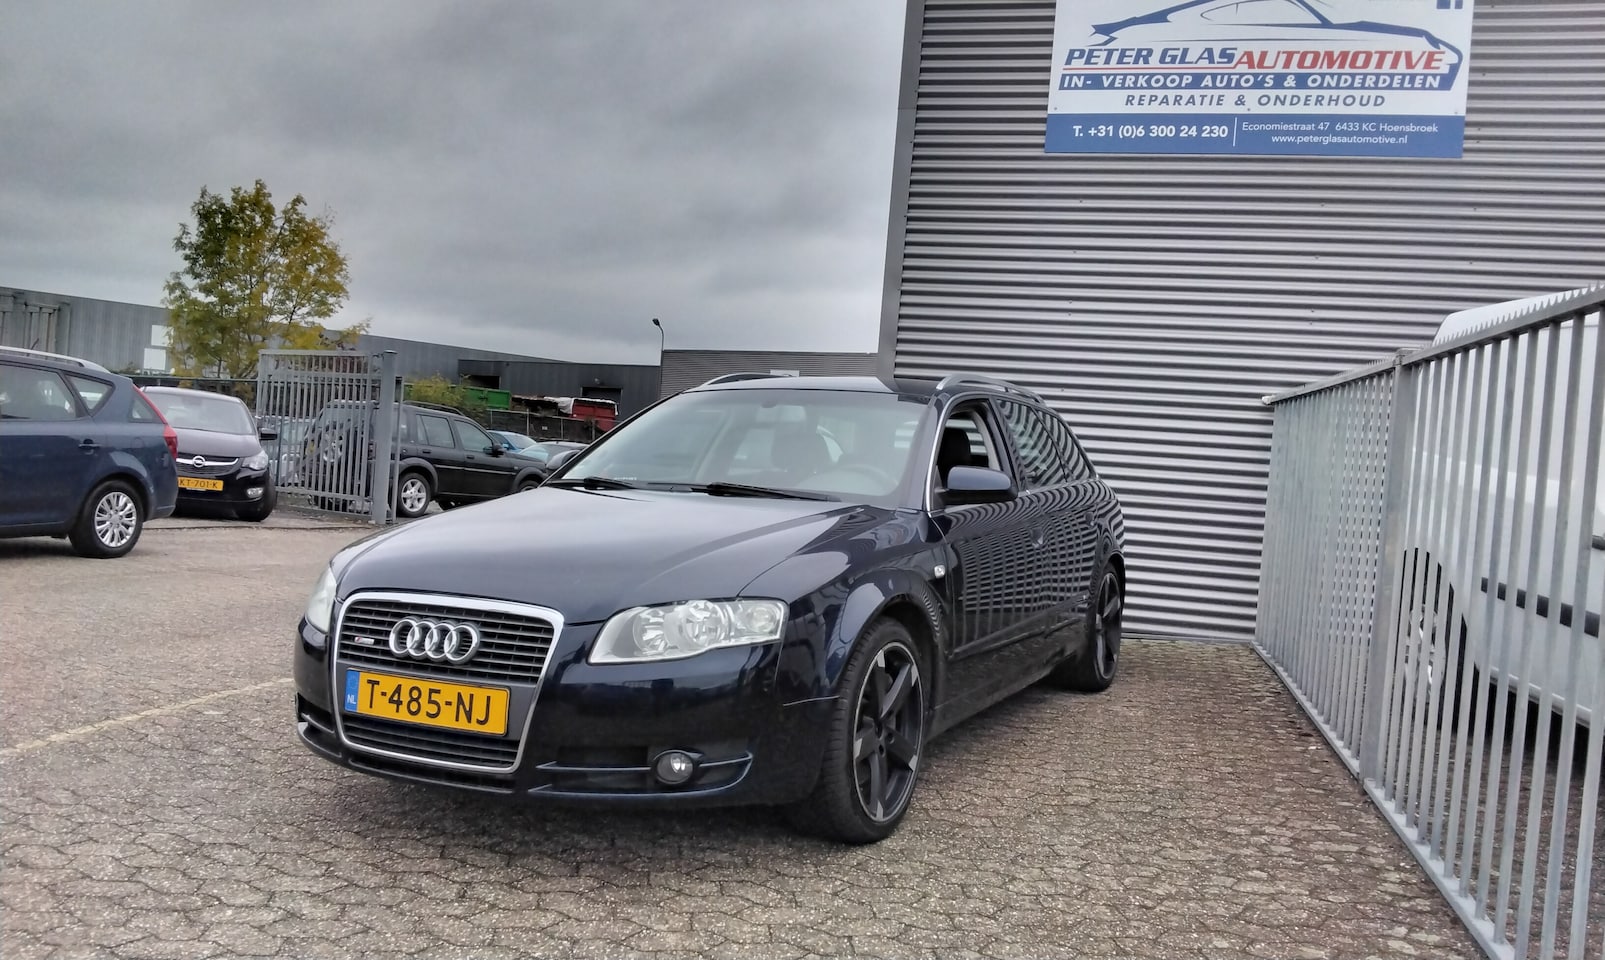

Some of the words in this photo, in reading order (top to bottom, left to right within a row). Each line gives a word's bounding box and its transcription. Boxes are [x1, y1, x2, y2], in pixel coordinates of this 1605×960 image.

[1064, 47, 1154, 66] PETER
[1063, 75, 1092, 88] IN-
[1101, 74, 1193, 88] VERKOOP
[1200, 74, 1275, 88] AUTO'S
[1283, 75, 1297, 87] &
[1306, 74, 1441, 88] ONDERDELEN
[1125, 94, 1226, 107] REPARATIE
[1234, 95, 1247, 106] &
[1257, 94, 1386, 107] ONDERHOUD
[1072, 125, 1084, 137] T.
[1088, 125, 1114, 137] +31
[1118, 125, 1146, 139] (0)6
[1149, 125, 1176, 138] 300
[1179, 125, 1198, 138] 24
[1201, 125, 1229, 138] 230
[1242, 122, 1316, 132] Economiestraat
[1317, 122, 1331, 131] 47
[1335, 122, 1360, 132] 6433
[1362, 122, 1377, 132] KC
[1379, 123, 1439, 133] Hoensbroek
[1271, 133, 1408, 145] www.peterglasautomotive.nl
[366, 678, 492, 726] T-485-NJ
